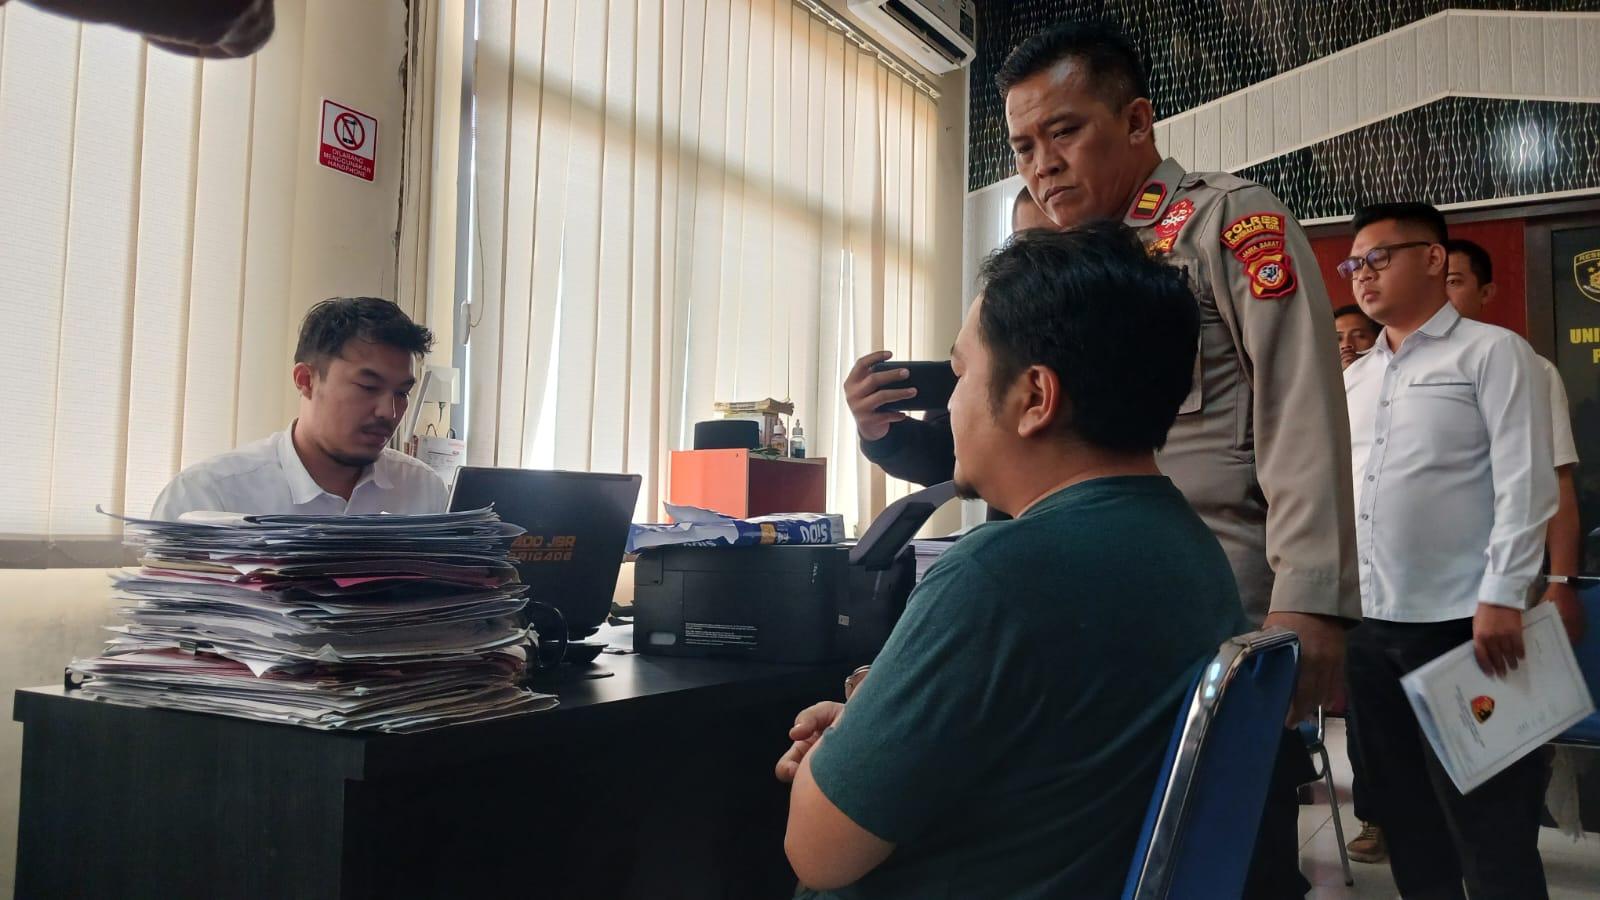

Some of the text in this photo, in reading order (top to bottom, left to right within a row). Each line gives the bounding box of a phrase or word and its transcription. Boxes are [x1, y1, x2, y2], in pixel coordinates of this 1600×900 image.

[323, 152, 371, 173] MENGGUNAKAN
[332, 149, 364, 165] DILARANG
[327, 160, 366, 177] HANDPHONE
[1224, 215, 1279, 240] POLRES
[1242, 240, 1280, 258] JAWA BARAT
